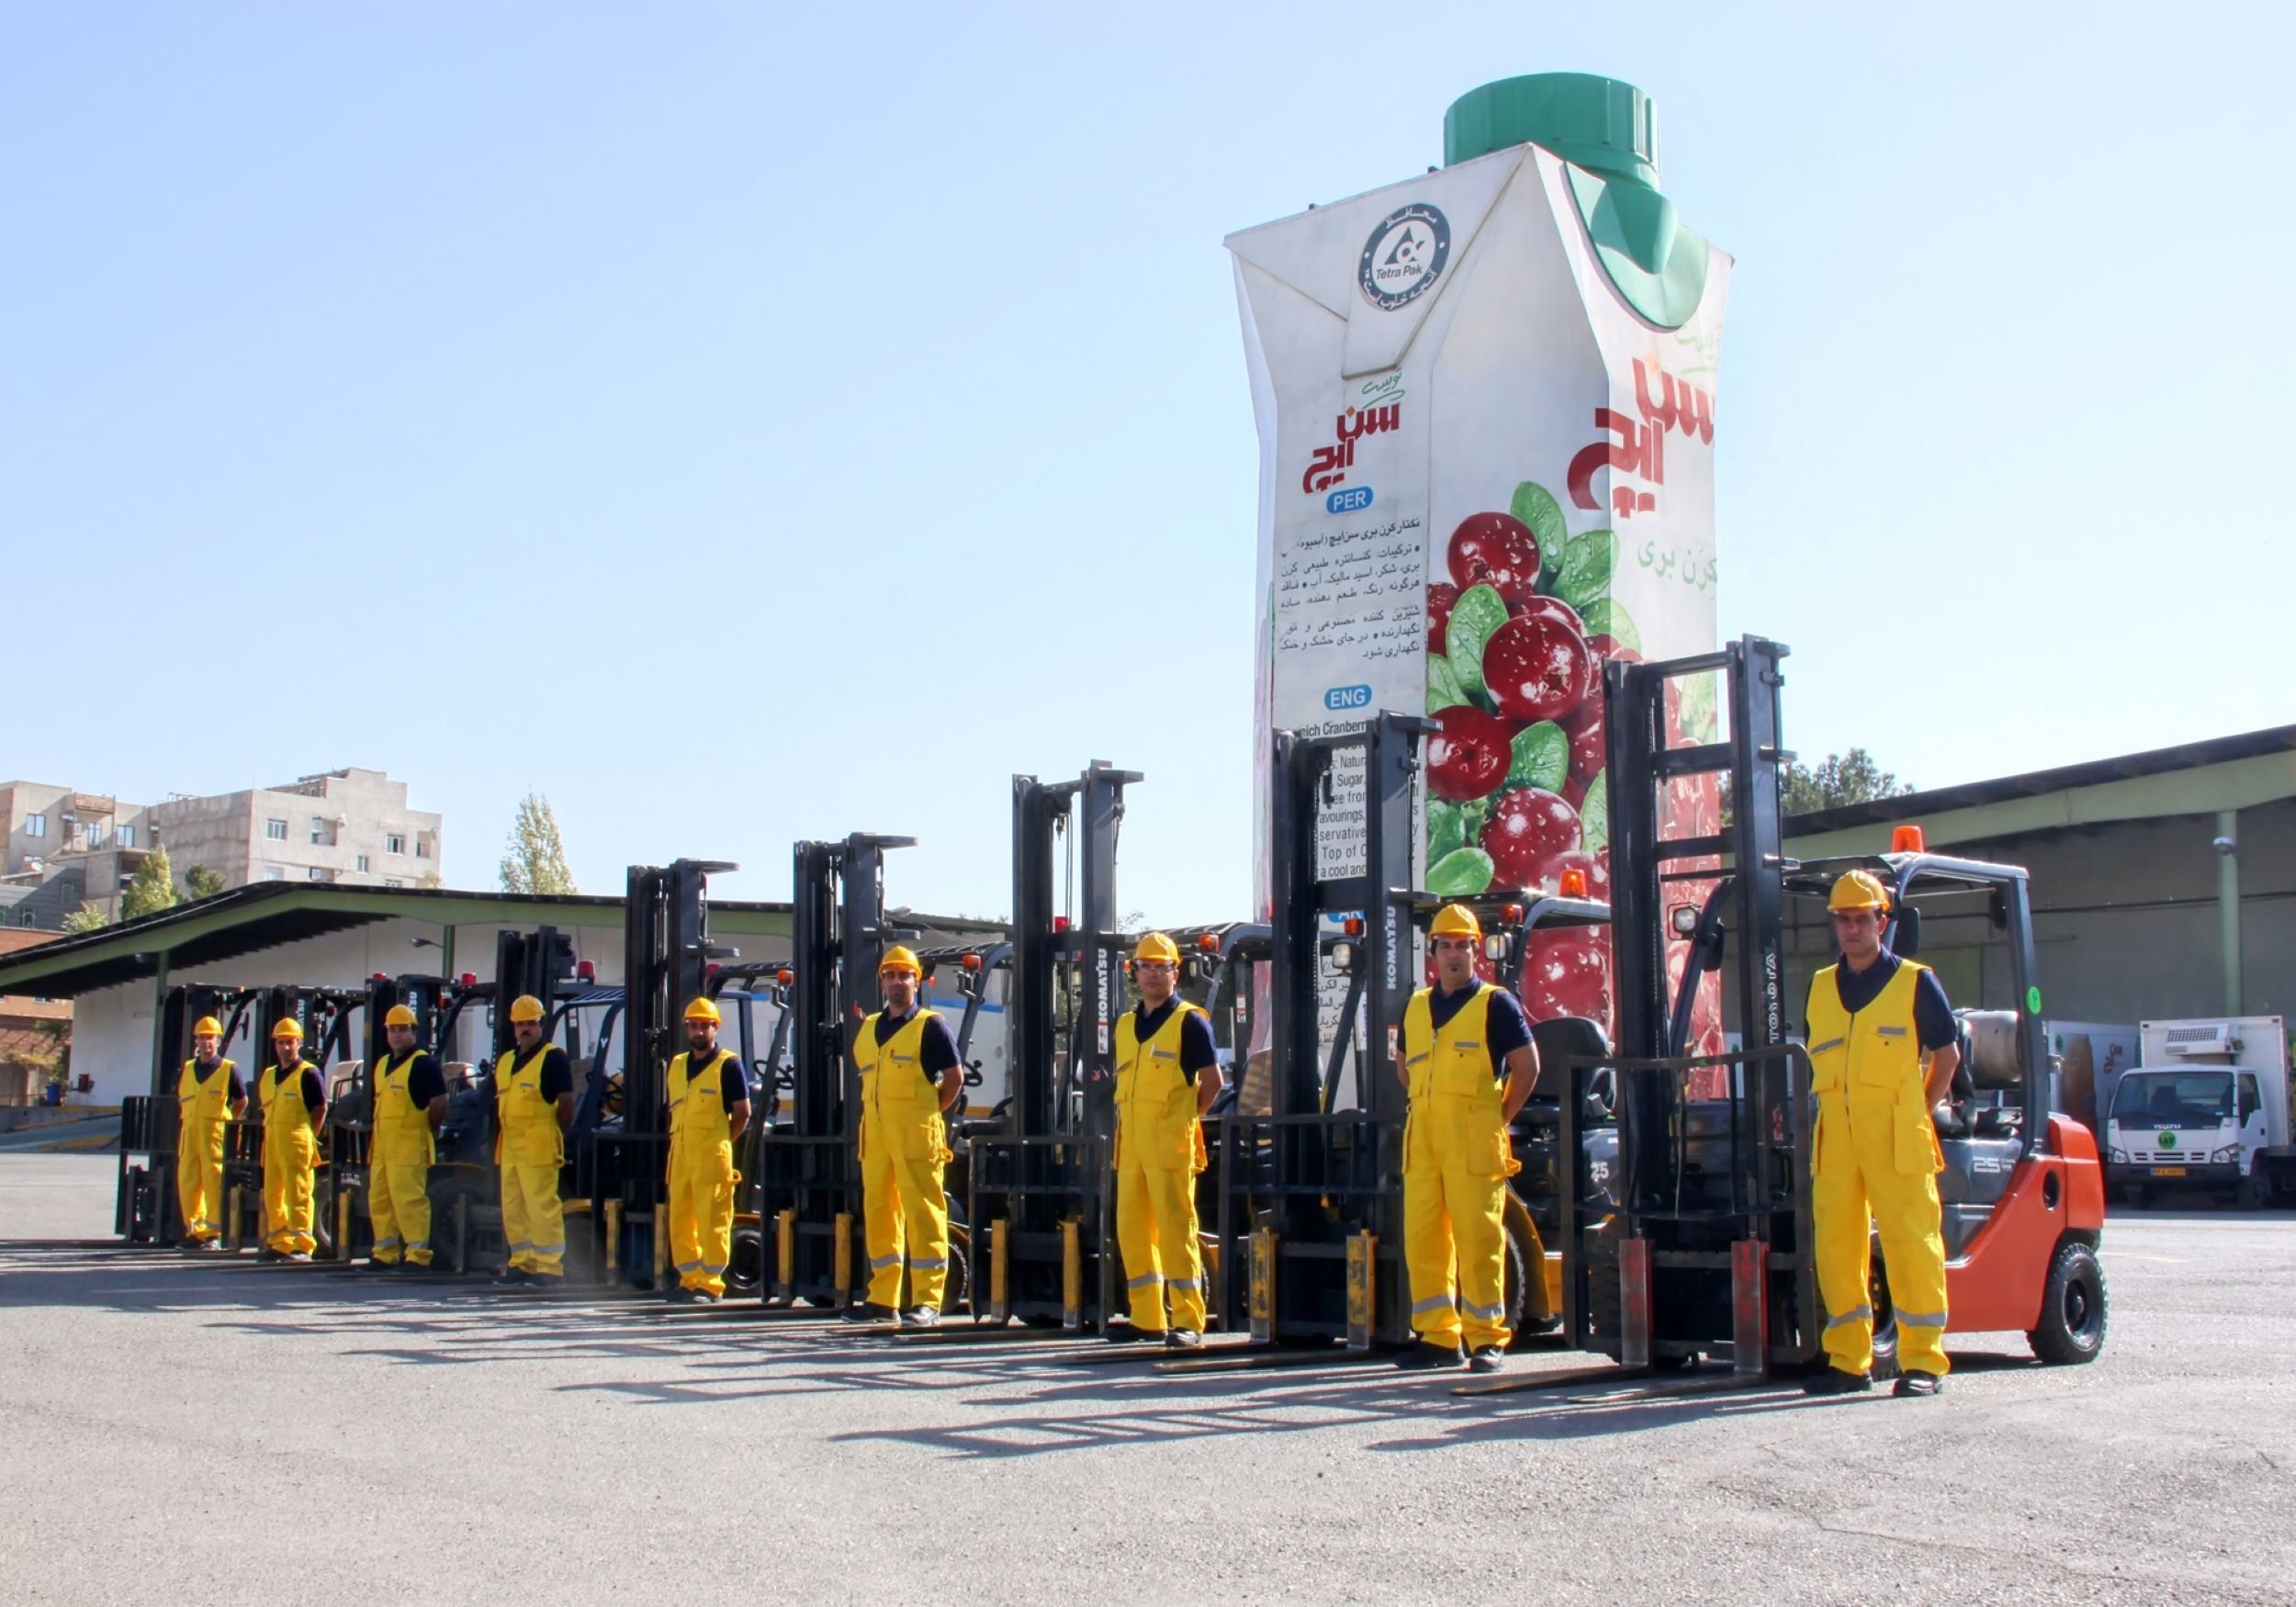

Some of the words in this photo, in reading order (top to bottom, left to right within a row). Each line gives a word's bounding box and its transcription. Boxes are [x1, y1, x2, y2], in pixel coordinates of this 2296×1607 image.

[1376, 267, 1401, 280] Tetra
[1402, 264, 1424, 276] Pak
[1333, 491, 1367, 511] PER
[1360, 528, 1378, 540] بری
[1303, 558, 1328, 574] طبیعی
[1638, 540, 1676, 580] بری
[1353, 567, 1372, 582] اسید
[1390, 577, 1420, 593] هرگونه
[1336, 588, 1357, 604] طعم
[1363, 610, 1384, 623] کننده
[1304, 624, 1311, 633] و
[1381, 622, 1421, 639] نگهدارنده
[1336, 632, 1355, 646] جای
[1357, 633, 1368, 644] در
[1384, 640, 1420, 657] نگهداری
[1330, 688, 1367, 708] ENG
[1323, 721, 1367, 735] Cranberr
[1334, 794, 1345, 805] ee
[1319, 808, 1367, 824] avourings,
[1319, 827, 1367, 841] servative
[1322, 846, 1342, 861] Top
[1345, 844, 1356, 858] of
[1328, 863, 1348, 878] cool
[1385, 905, 1397, 990] KOMATSU
[1096, 948, 1109, 1022] KOMATSU
[1765, 952, 1780, 1044] TOYOTA
[1590, 1161, 1610, 1180] 25
[1973, 1157, 2000, 1173] 25
